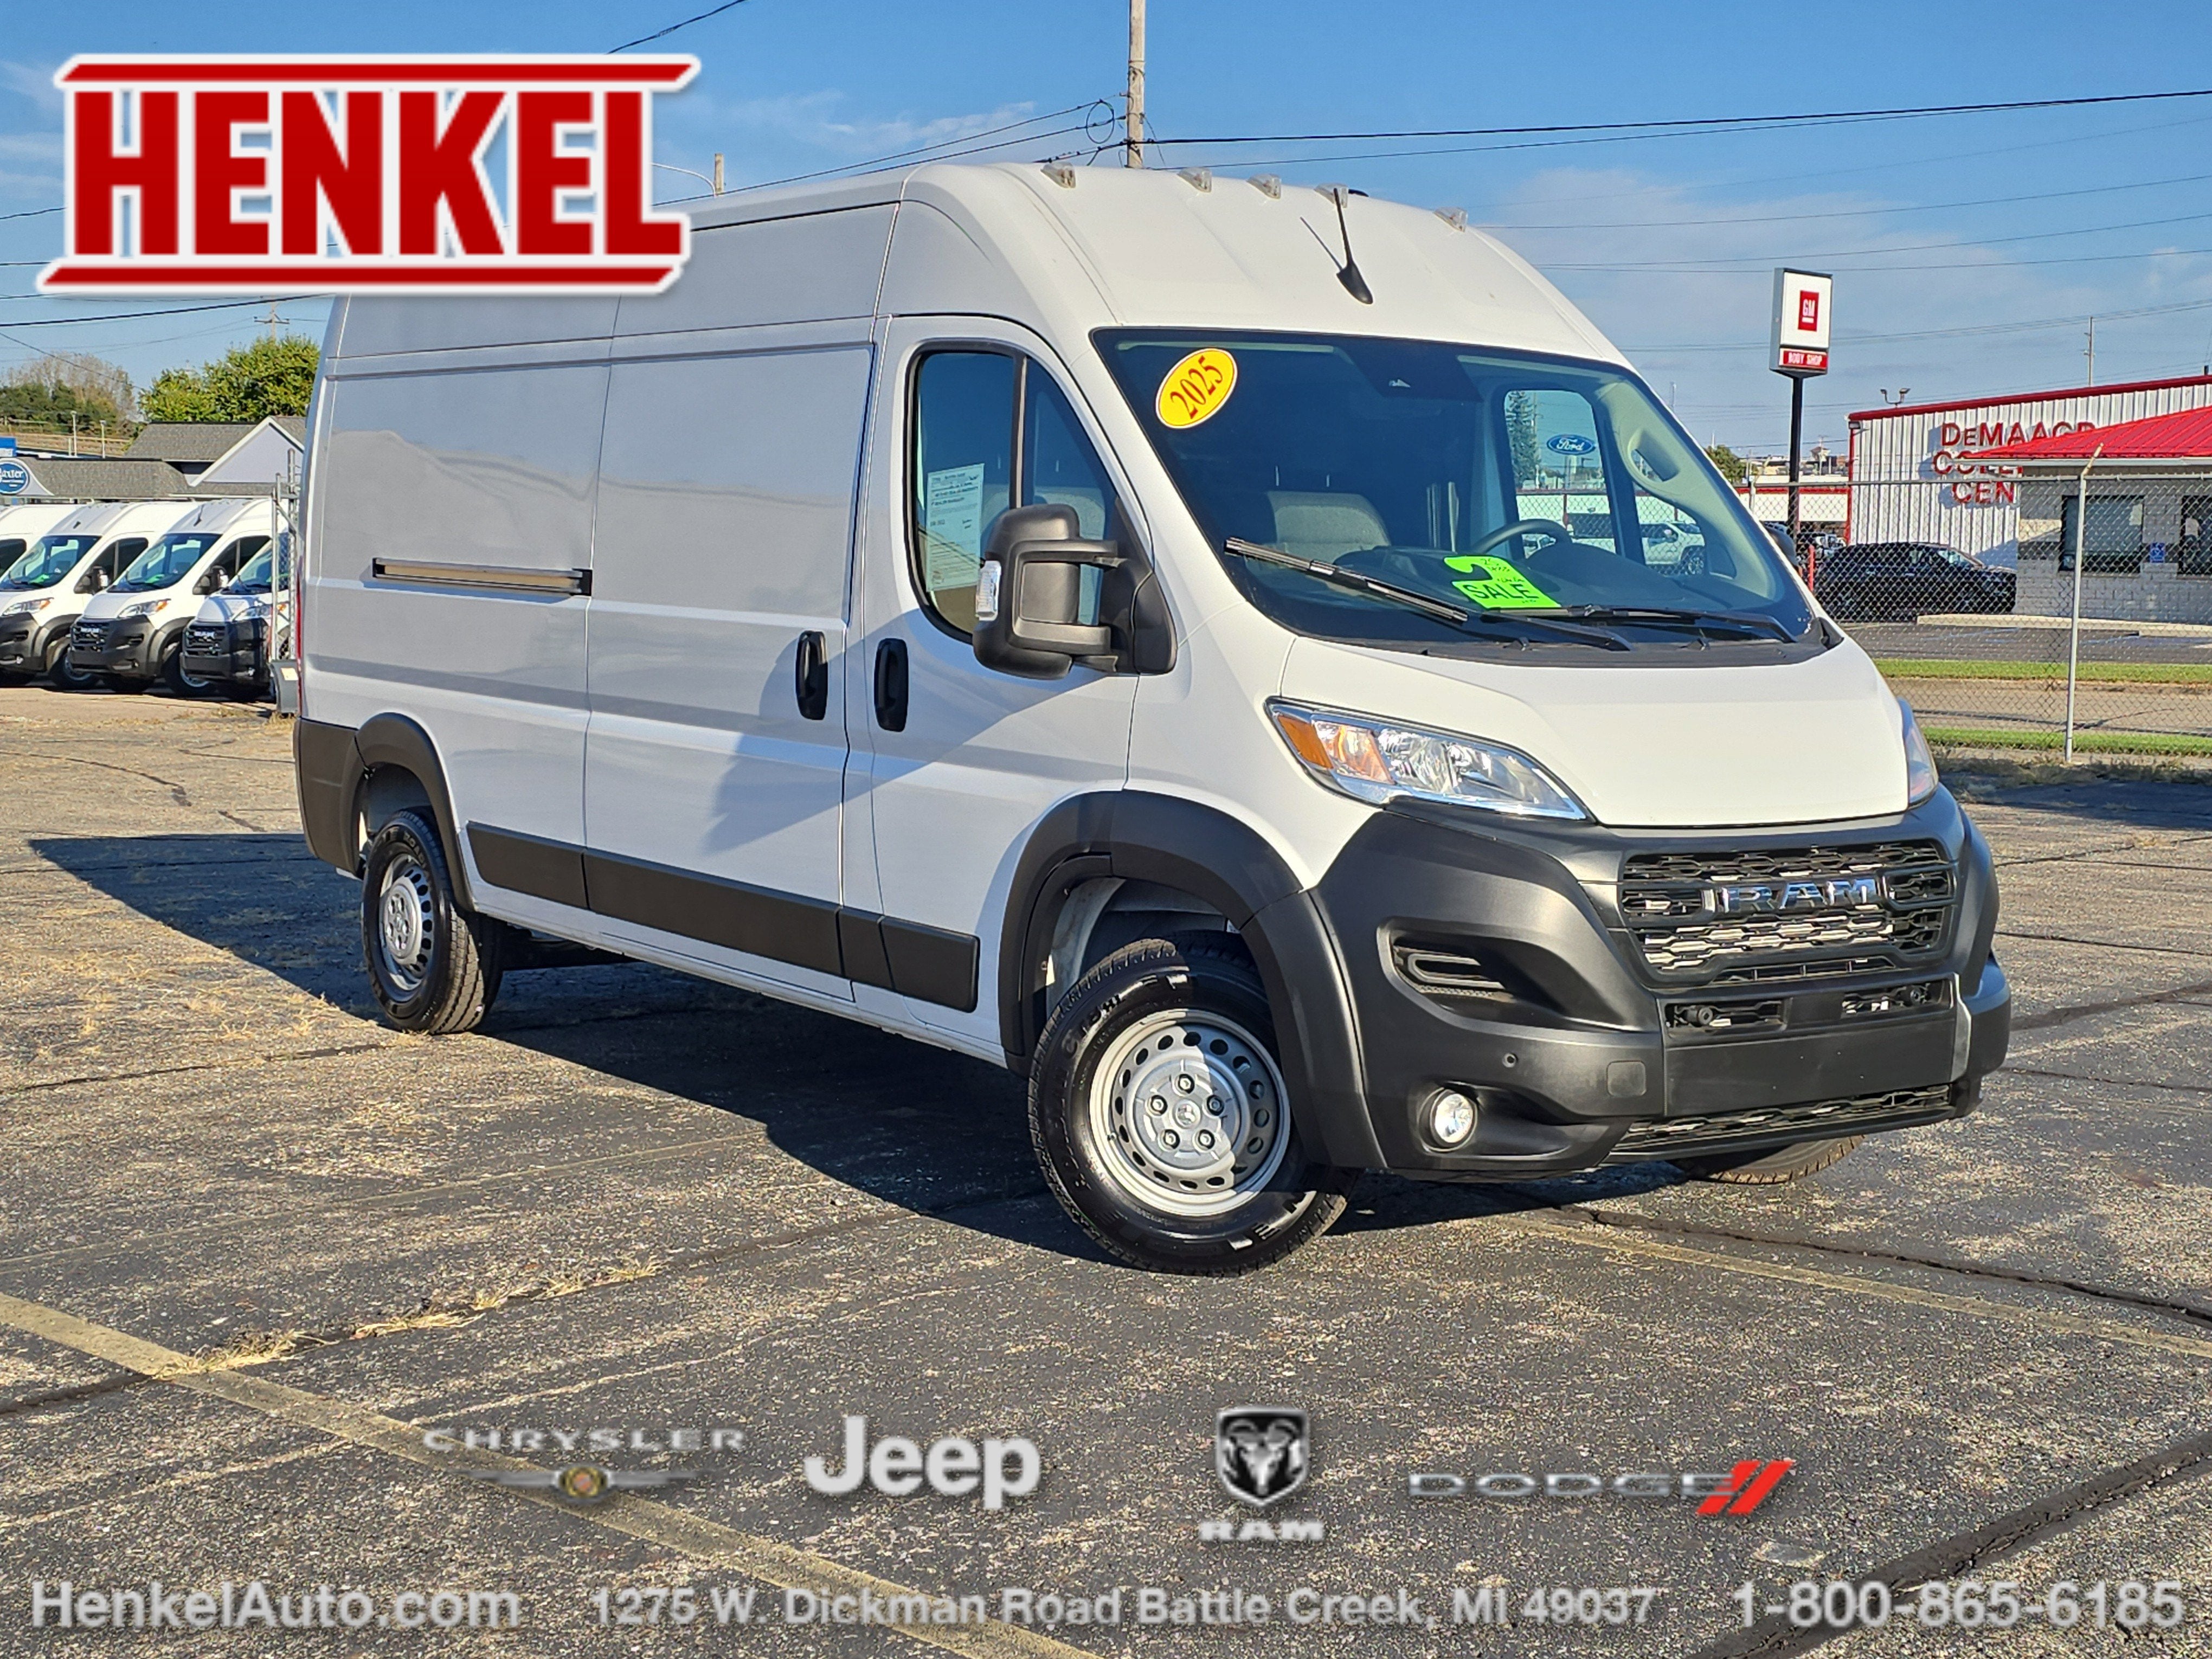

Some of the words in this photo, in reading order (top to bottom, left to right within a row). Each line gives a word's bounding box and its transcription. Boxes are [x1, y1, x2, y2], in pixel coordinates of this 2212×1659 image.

[1802, 299, 1816, 317] GM
[1787, 352, 1804, 365] BODY
[1806, 355, 1822, 366] SHOP
[1170, 355, 1223, 419] 2025
[1556, 438, 1585, 451] Ford
[1463, 583, 1539, 599] SALE
[1719, 879, 1877, 914] RAM
